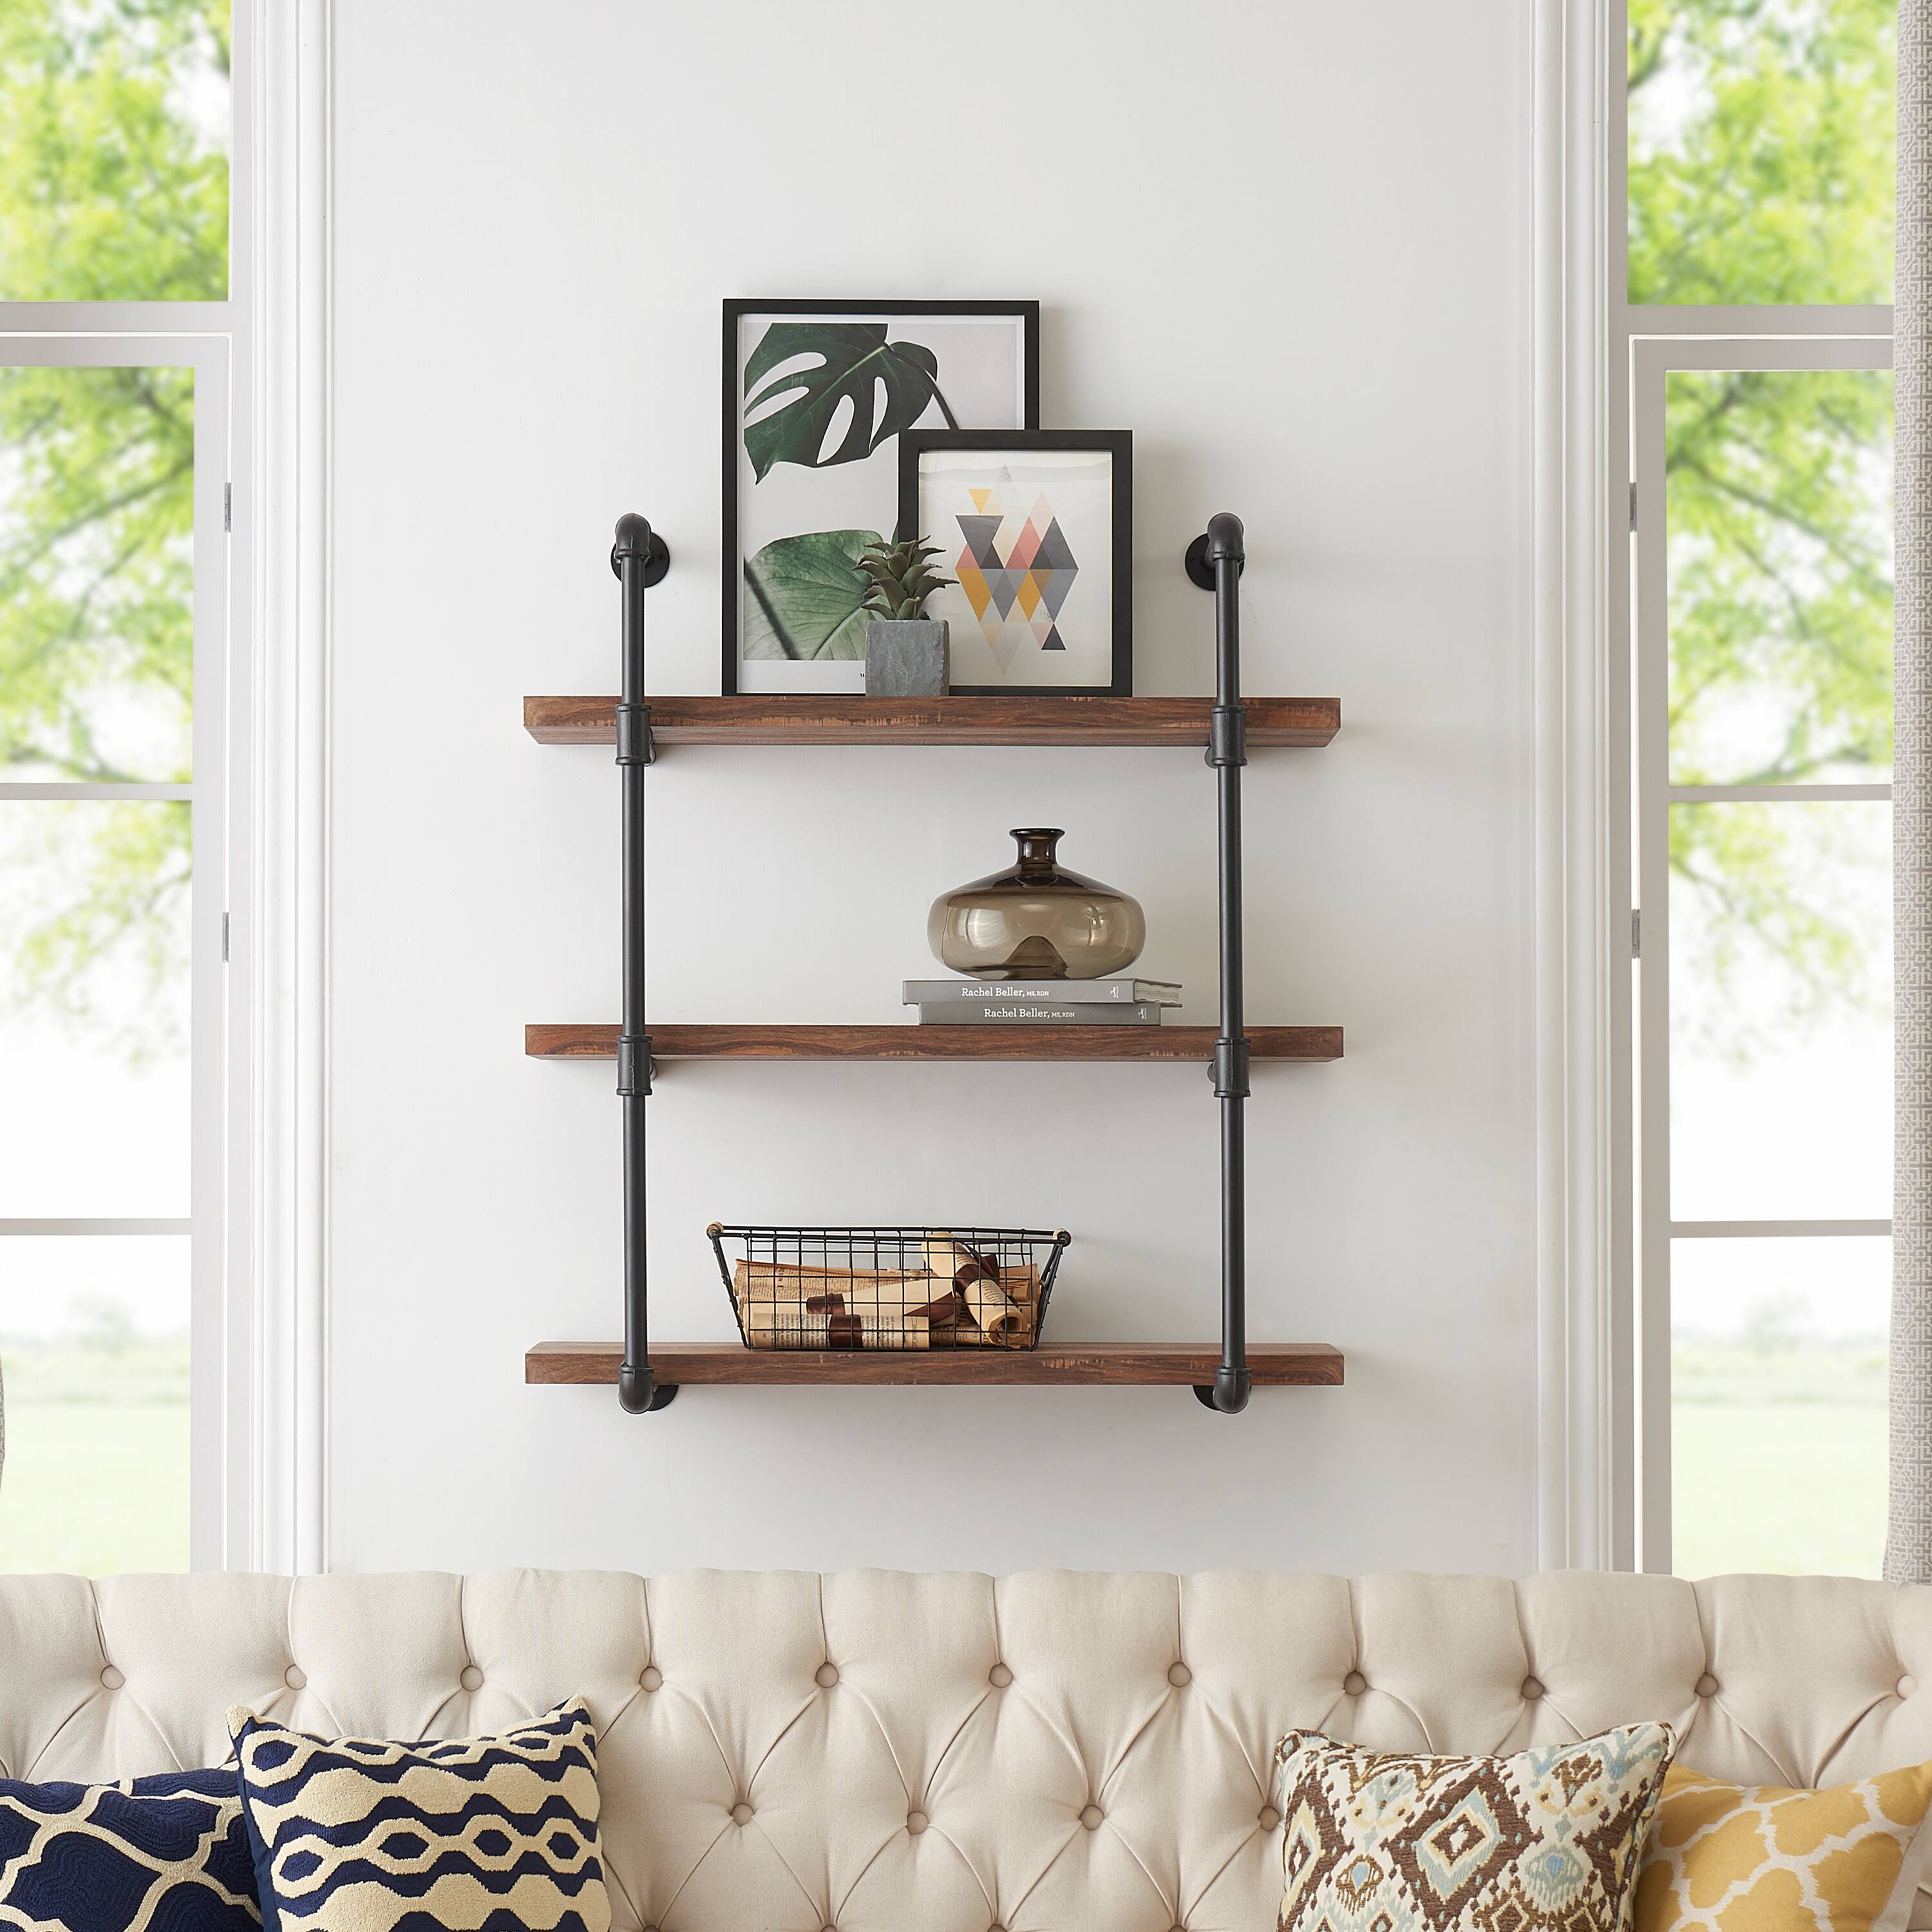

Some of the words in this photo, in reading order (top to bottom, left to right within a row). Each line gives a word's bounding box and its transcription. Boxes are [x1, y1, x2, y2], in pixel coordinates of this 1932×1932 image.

[961, 987, 993, 996] Rachel
[996, 987, 1025, 998] Beller,
[983, 1008, 1017, 1018] Rachel
[1019, 1008, 1050, 1019] Beller,
